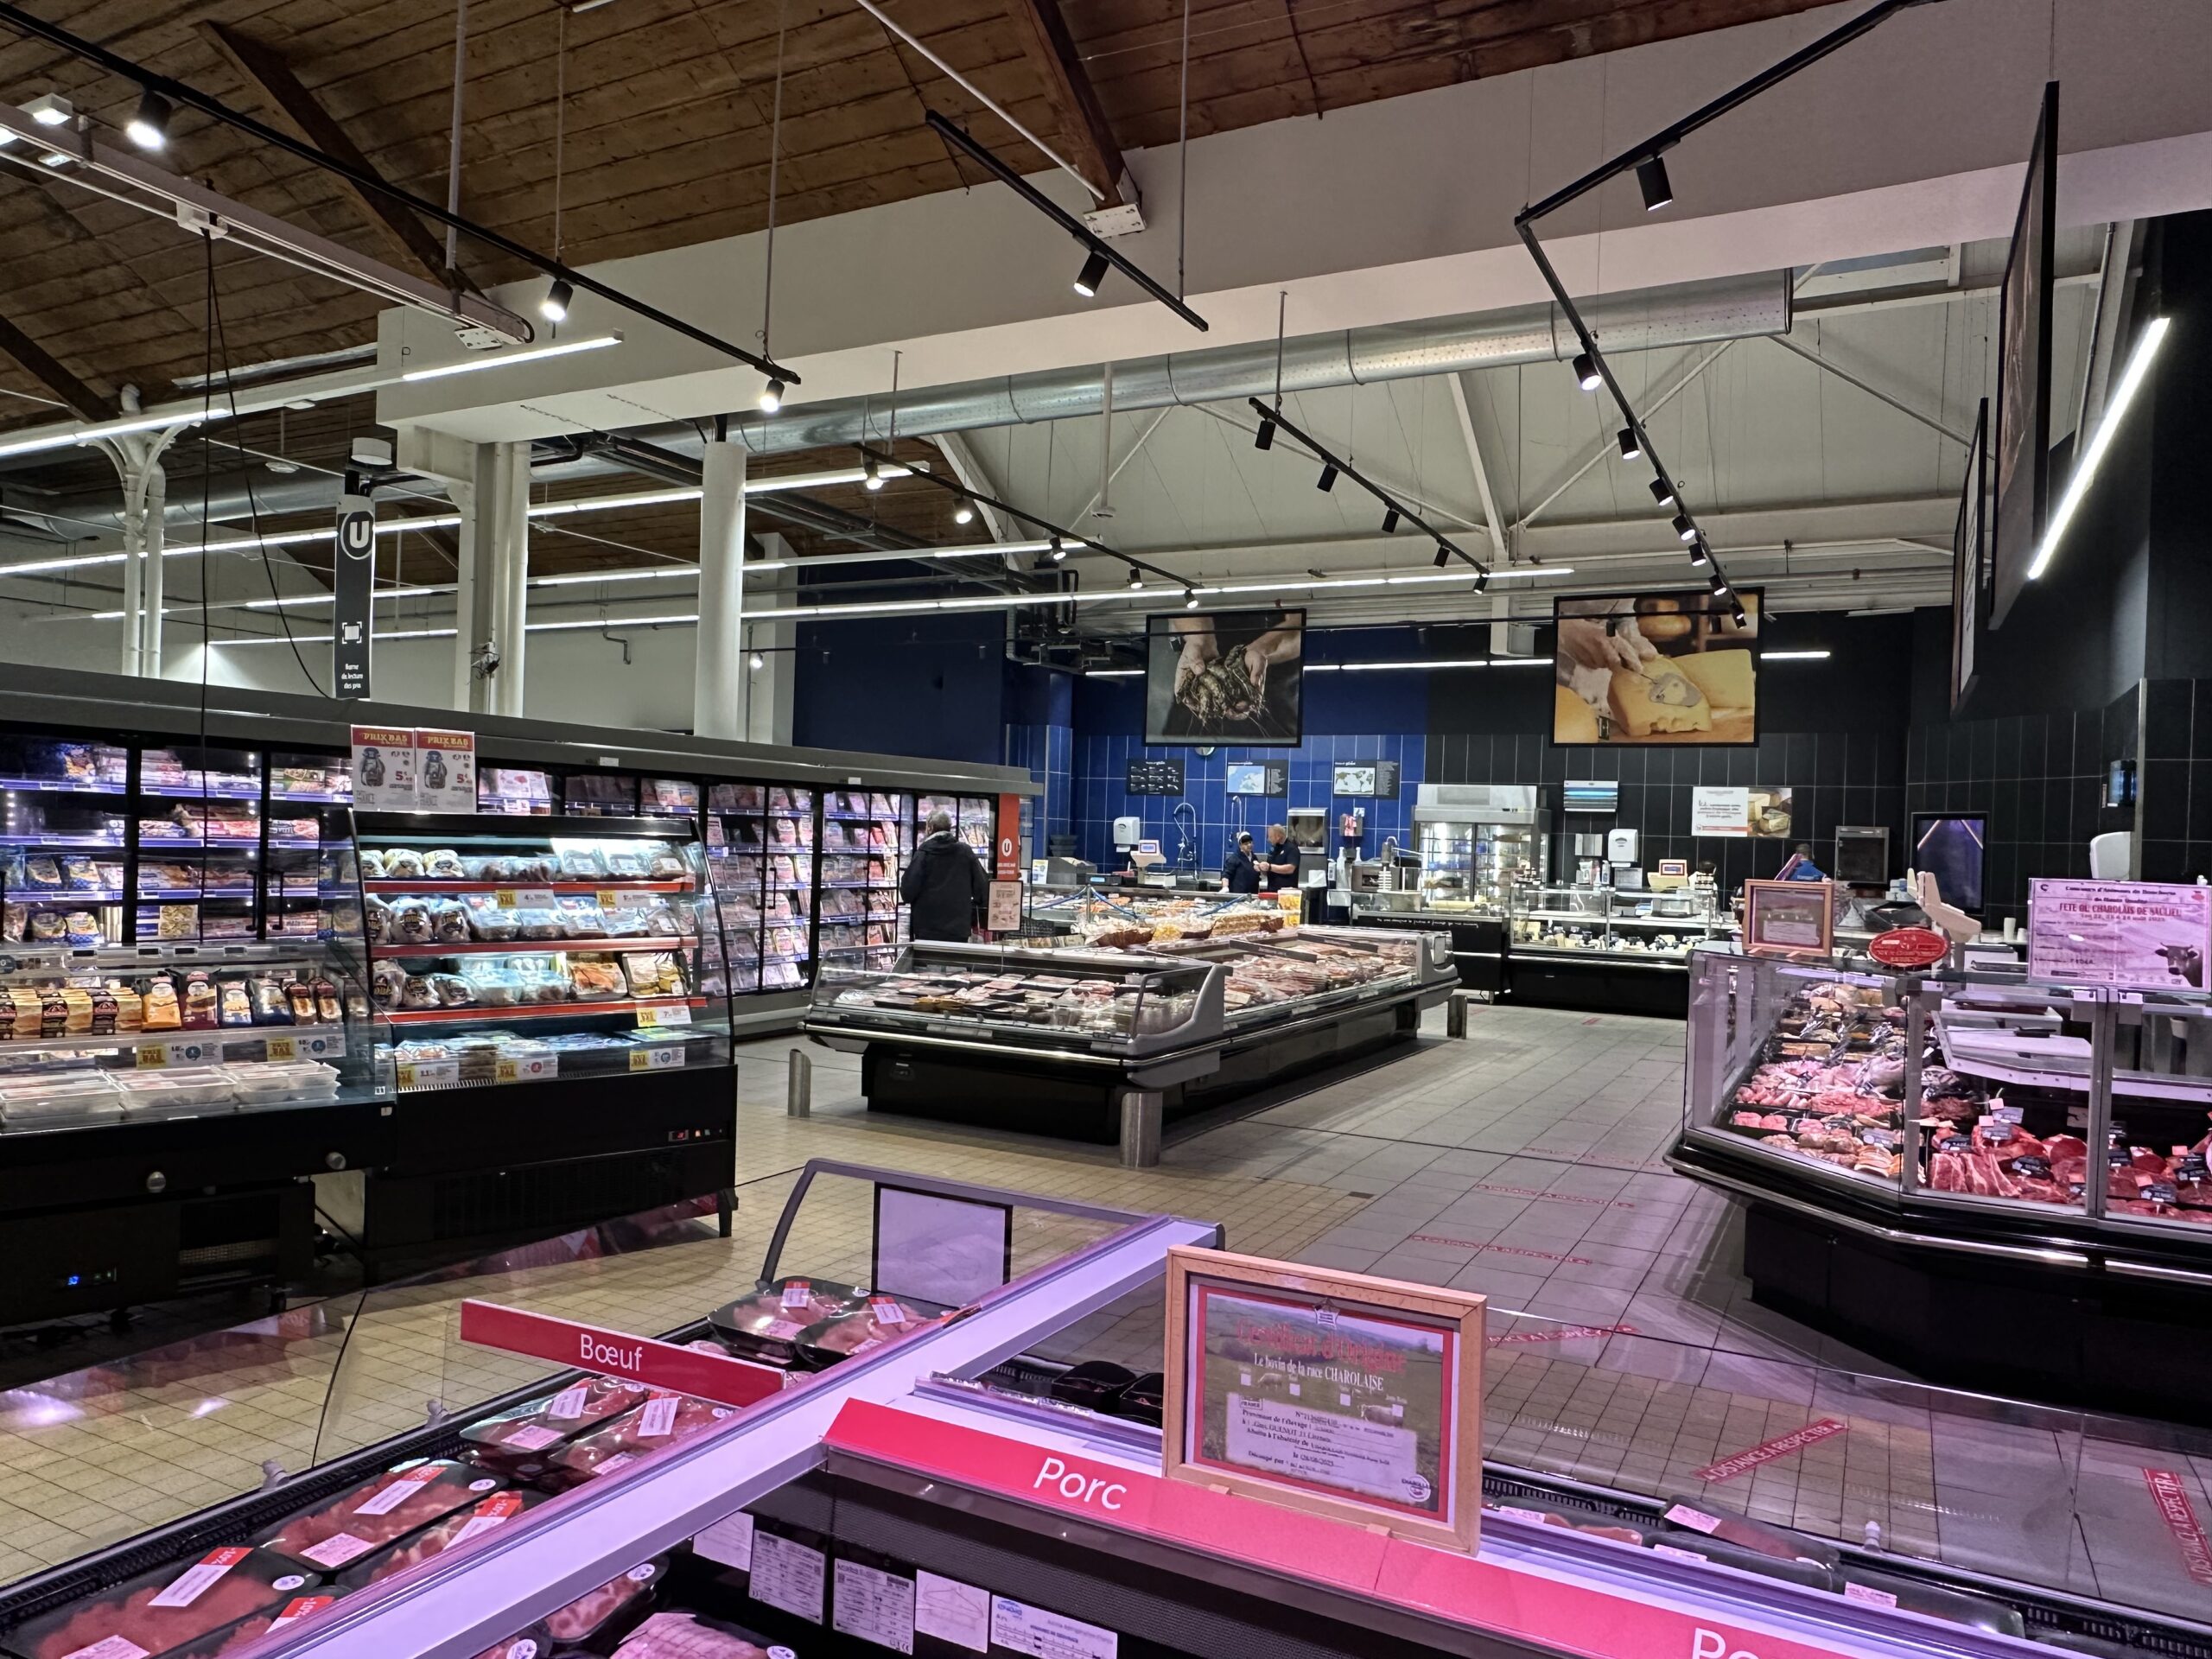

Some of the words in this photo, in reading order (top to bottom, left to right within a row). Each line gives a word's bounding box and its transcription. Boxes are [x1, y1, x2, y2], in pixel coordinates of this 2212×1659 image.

[349, 521, 370, 548] U
[2136, 906, 2148, 916] DE
[580, 1333, 643, 1372] Bœuf
[1254, 1352, 1263, 1367] Le
[1265, 1355, 1286, 1370] bovin
[1287, 1359, 1297, 1373] de
[1298, 1362, 1306, 1376] la
[1306, 1365, 1323, 1378] race
[1325, 1366, 1384, 1391] CHAROLAISE
[1711, 1448, 1771, 1478] DISTANCE
[1776, 1424, 1833, 1452] RESPECTER
[1033, 1456, 1128, 1510] Porc
